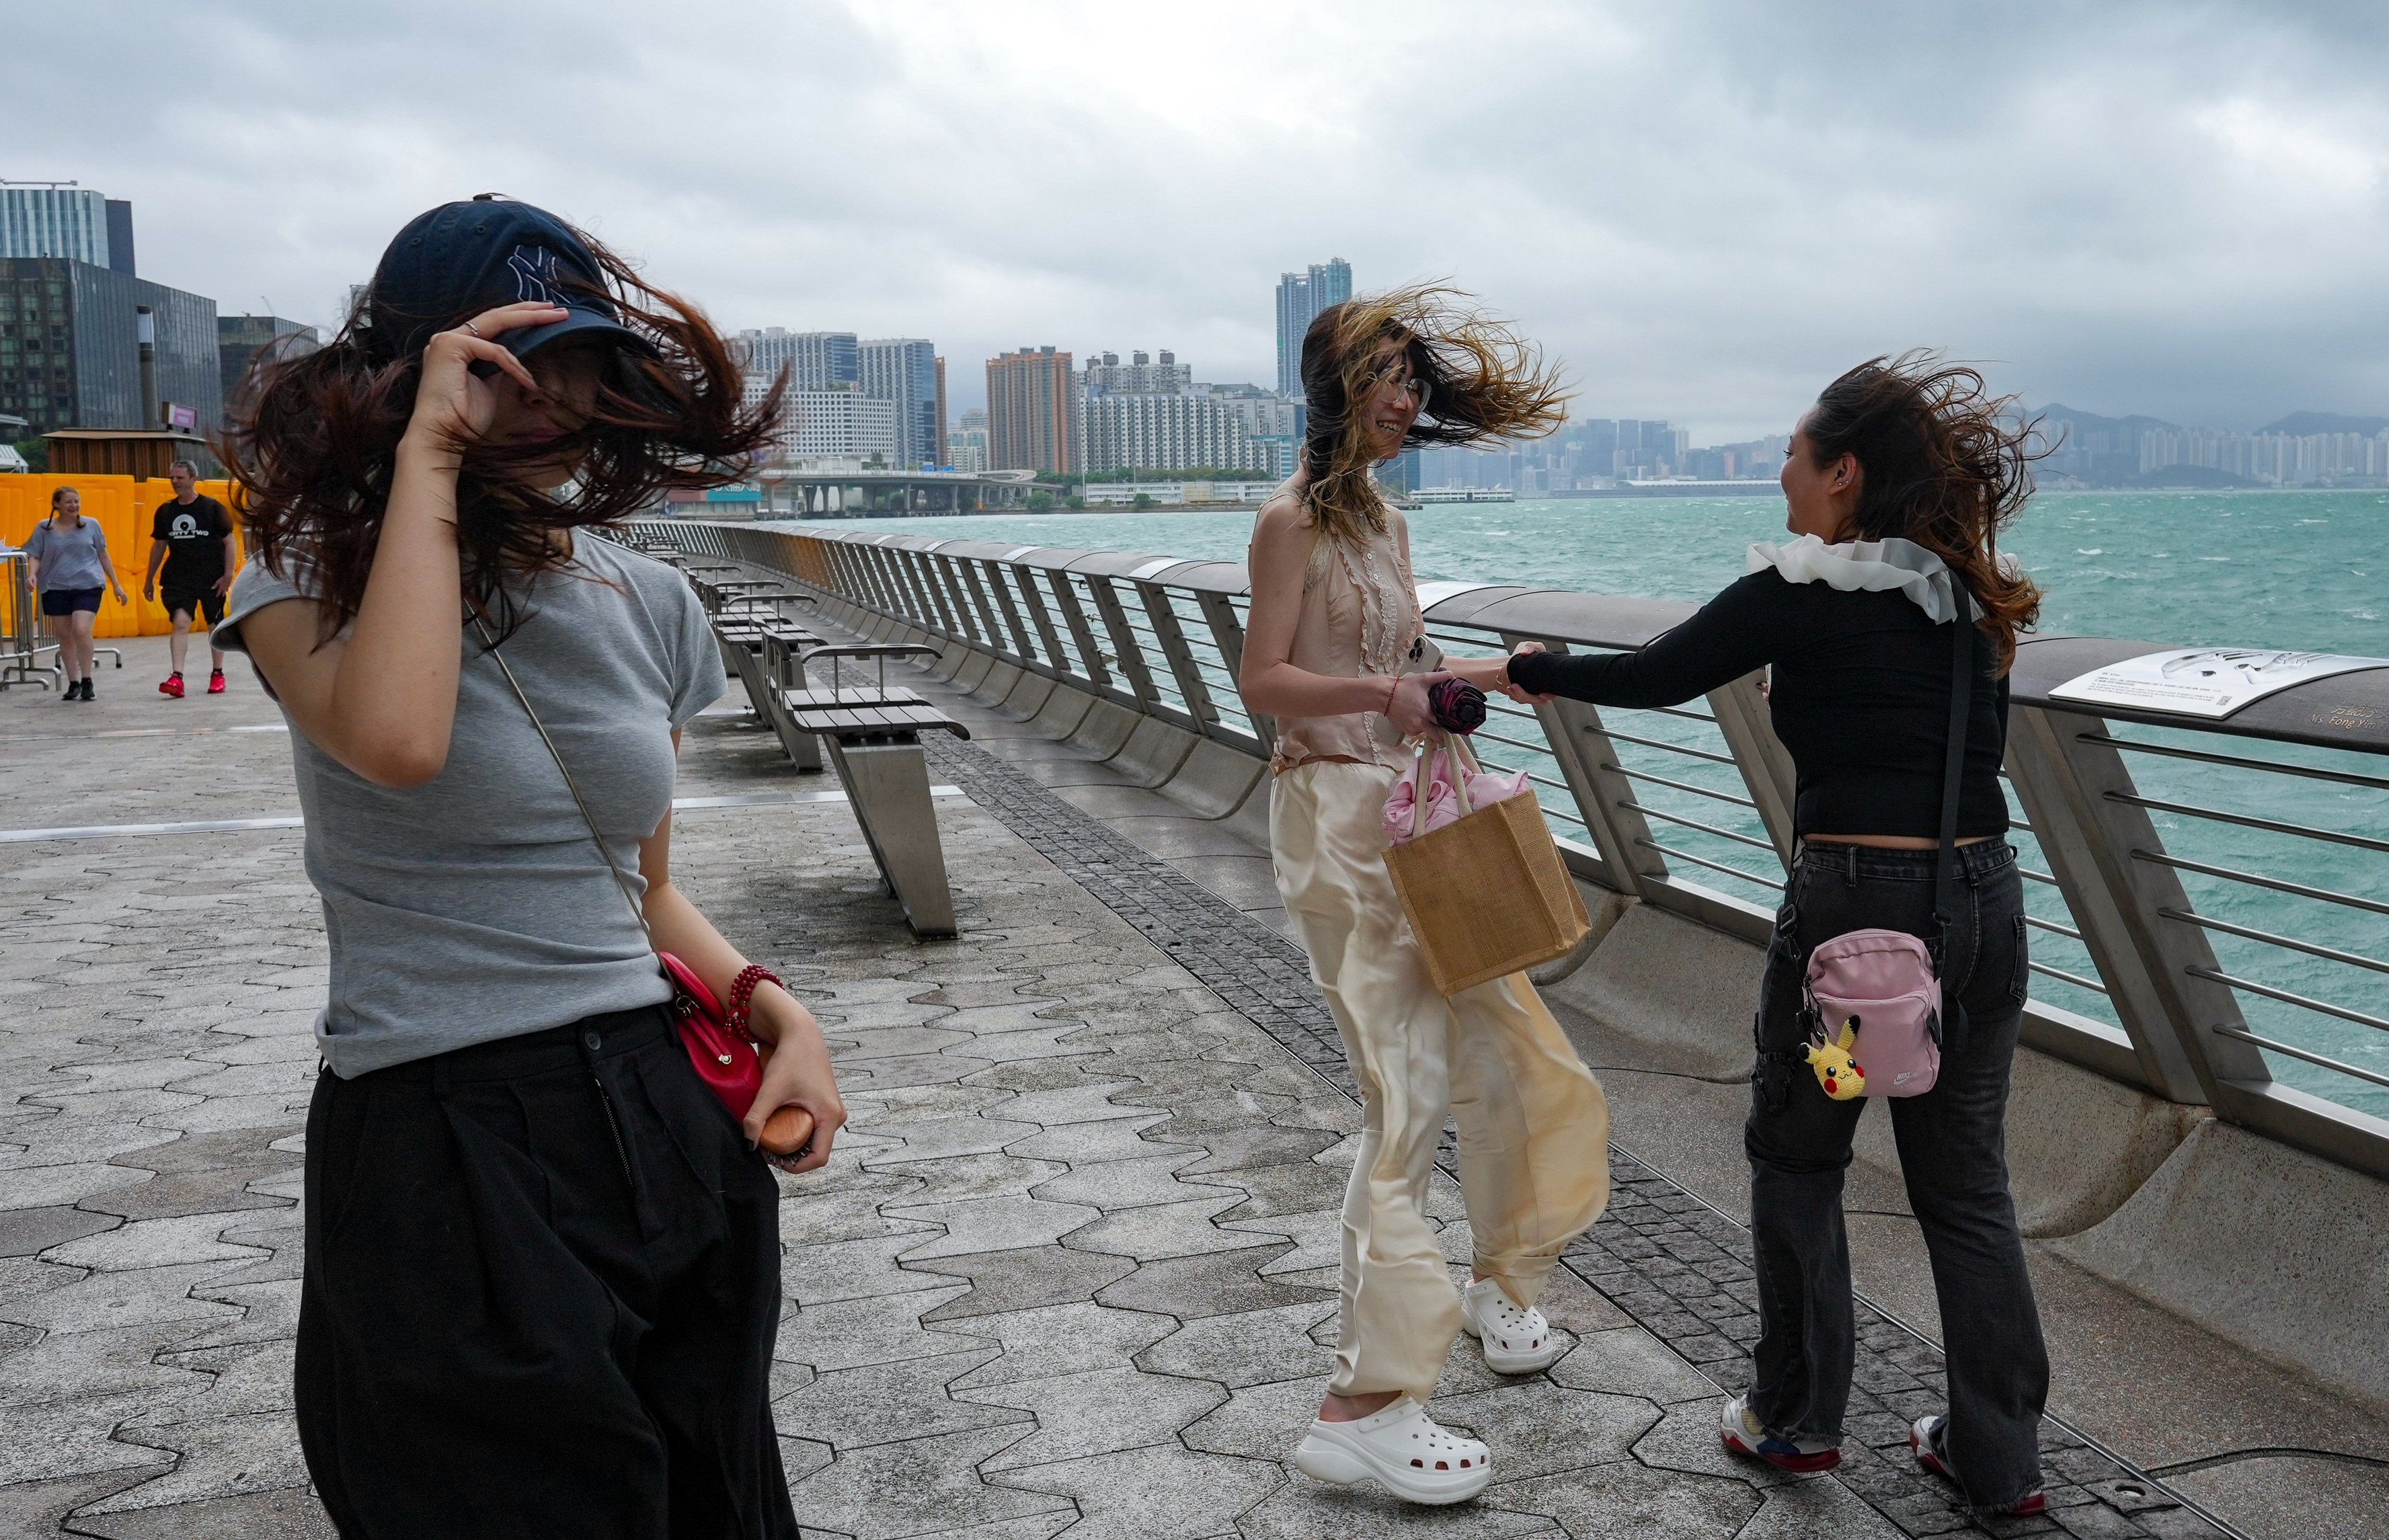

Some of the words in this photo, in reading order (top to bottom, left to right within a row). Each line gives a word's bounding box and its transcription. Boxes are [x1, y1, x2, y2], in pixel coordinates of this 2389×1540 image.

[2311, 713, 2325, 724] Ms.
[2328, 716, 2357, 729] Fong
[2357, 719, 2377, 730] Yim
[1897, 1071, 1914, 1081] NIKE
